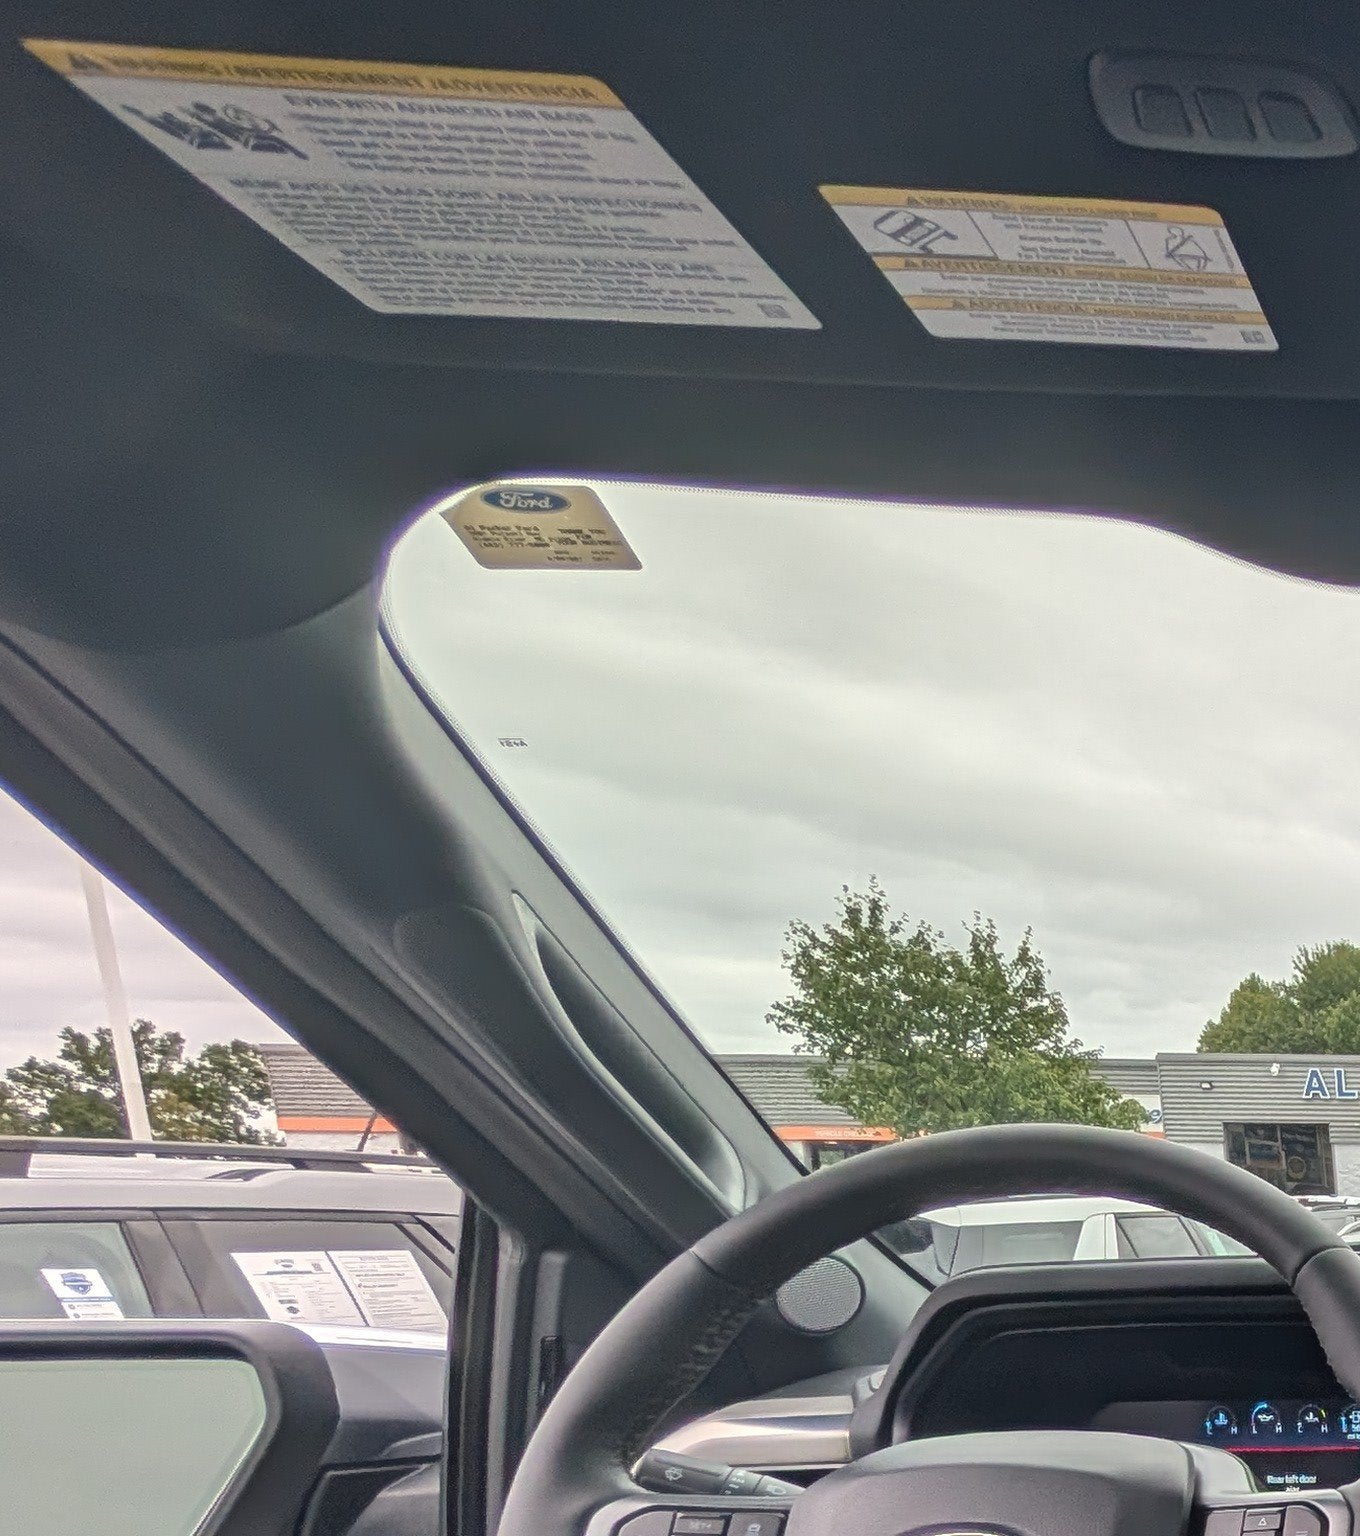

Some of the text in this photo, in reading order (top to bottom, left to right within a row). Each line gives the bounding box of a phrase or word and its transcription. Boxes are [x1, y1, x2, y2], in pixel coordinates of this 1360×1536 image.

[500, 493, 552, 509] Ford
[1303, 1068, 1359, 1100] AL
[1267, 1475, 1317, 1484] Rear left door
